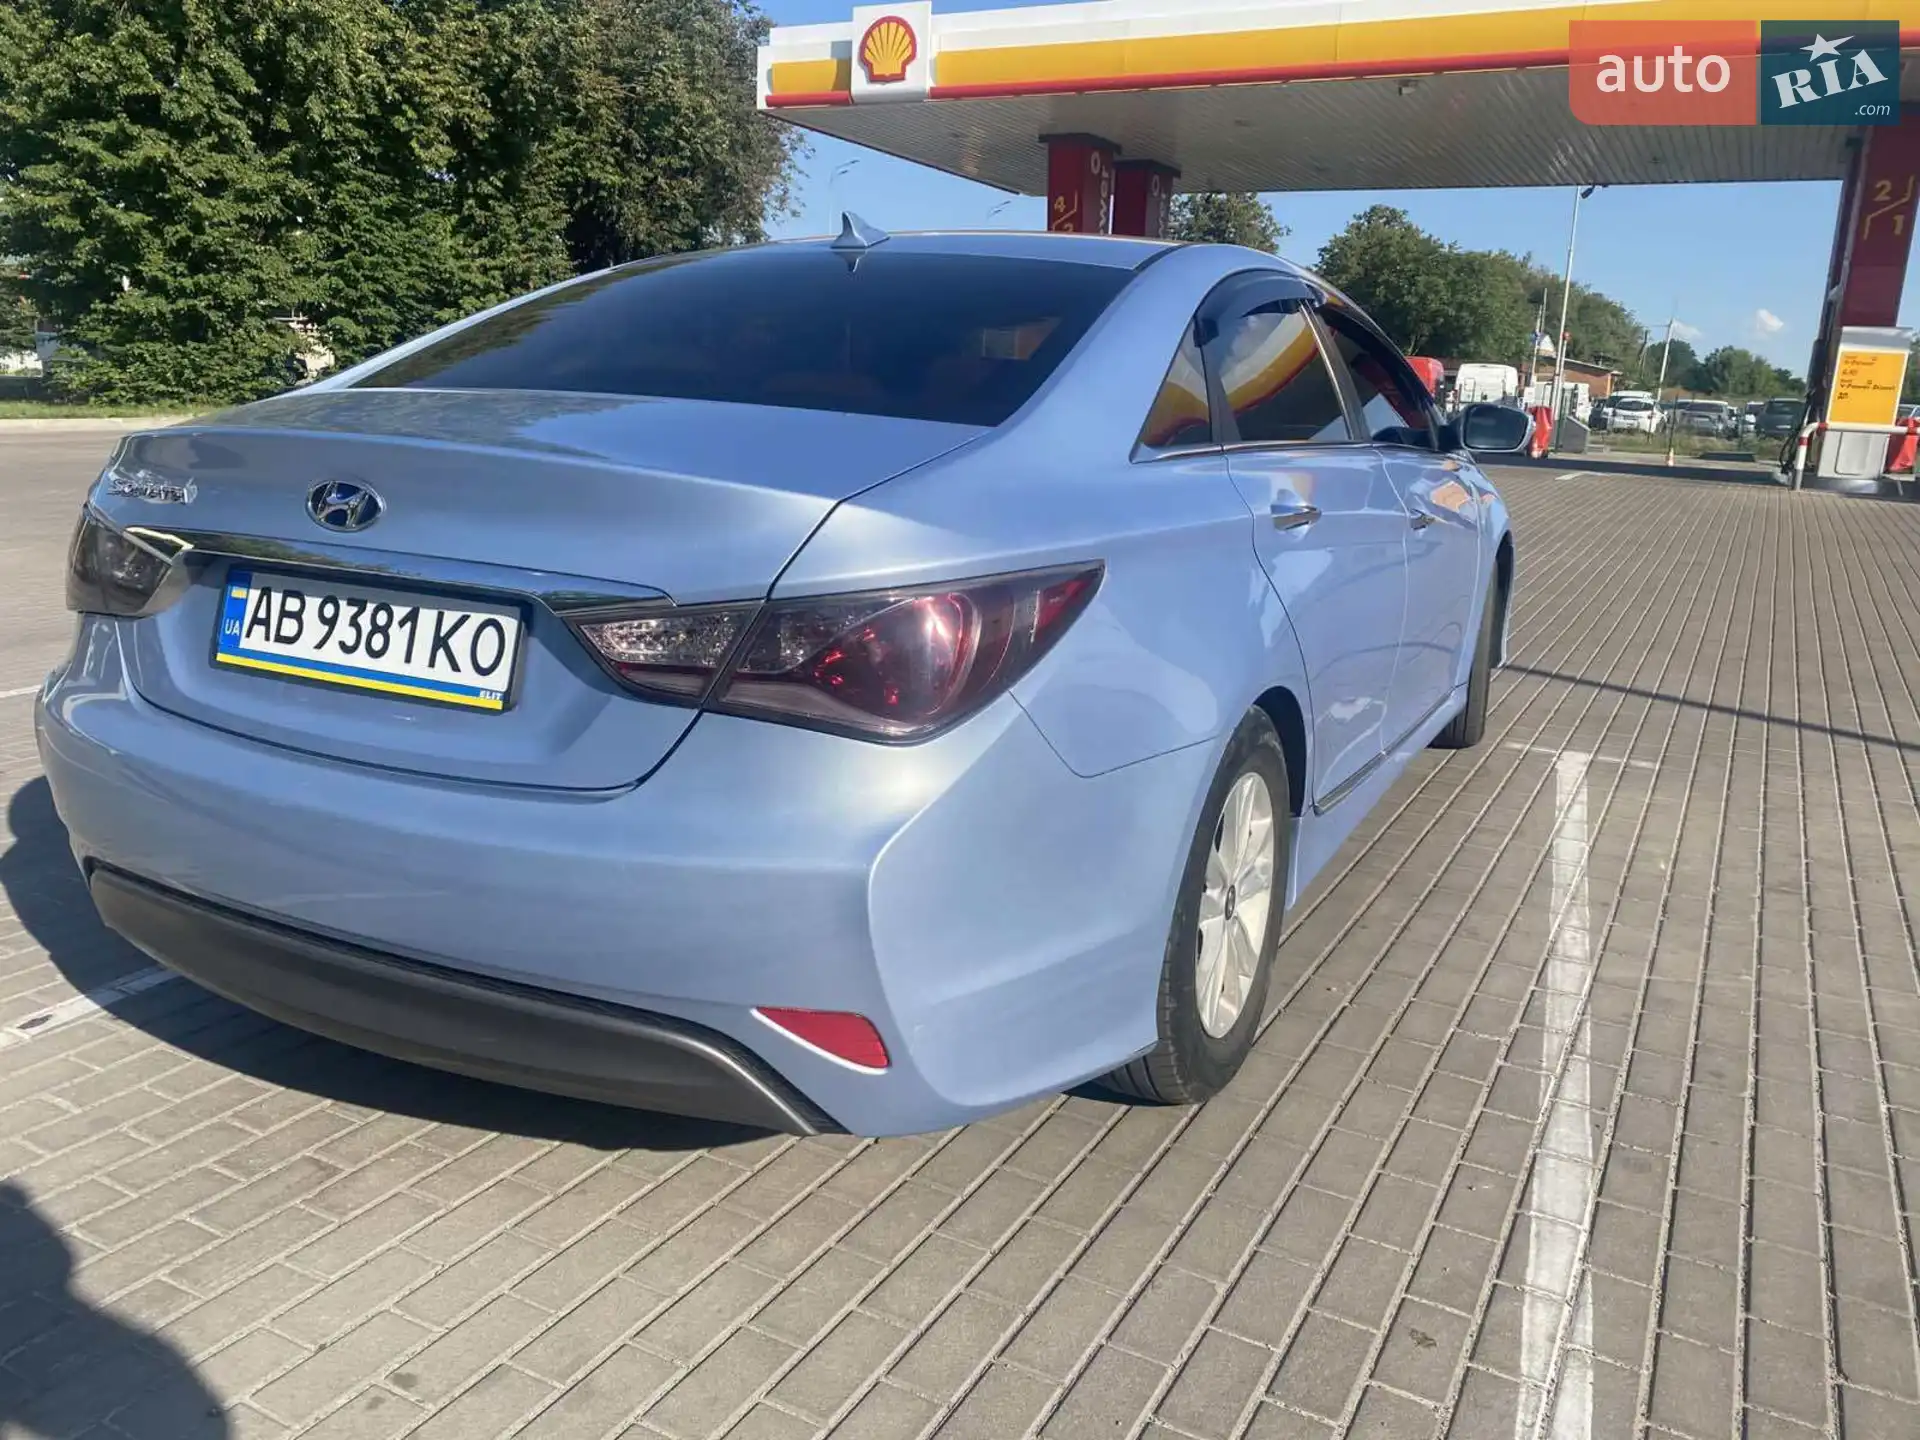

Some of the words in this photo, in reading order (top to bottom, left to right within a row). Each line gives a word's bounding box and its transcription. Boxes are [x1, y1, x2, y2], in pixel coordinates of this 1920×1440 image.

[1873, 180, 1892, 201] 2
[1893, 214, 1905, 235] 1
[224, 619, 241, 637] UA
[246, 586, 306, 645] AB
[313, 595, 420, 664] 9381
[428, 610, 506, 677] KO
